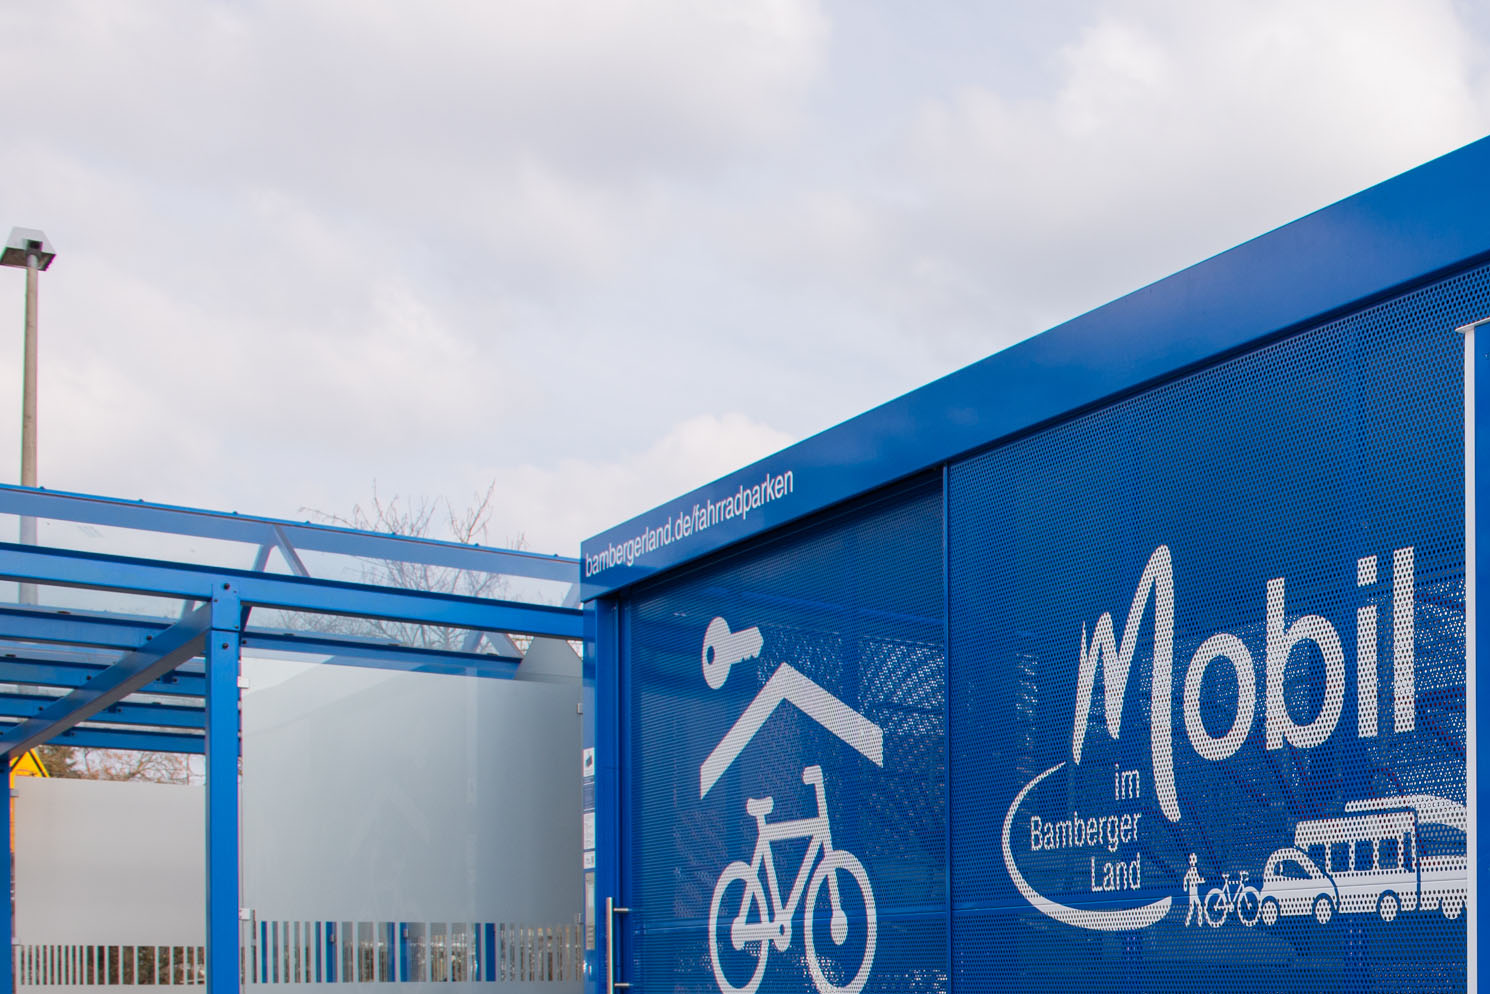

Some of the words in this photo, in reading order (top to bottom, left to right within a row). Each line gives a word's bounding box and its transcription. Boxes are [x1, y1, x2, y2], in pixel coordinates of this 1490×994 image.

[585, 470, 794, 577] bambergerland.de/fahrradparken
[1072, 545, 1415, 822] Mobil
[1114, 764, 1141, 800] im
[1030, 813, 1141, 853] Bamberger
[1091, 853, 1141, 892] Land
